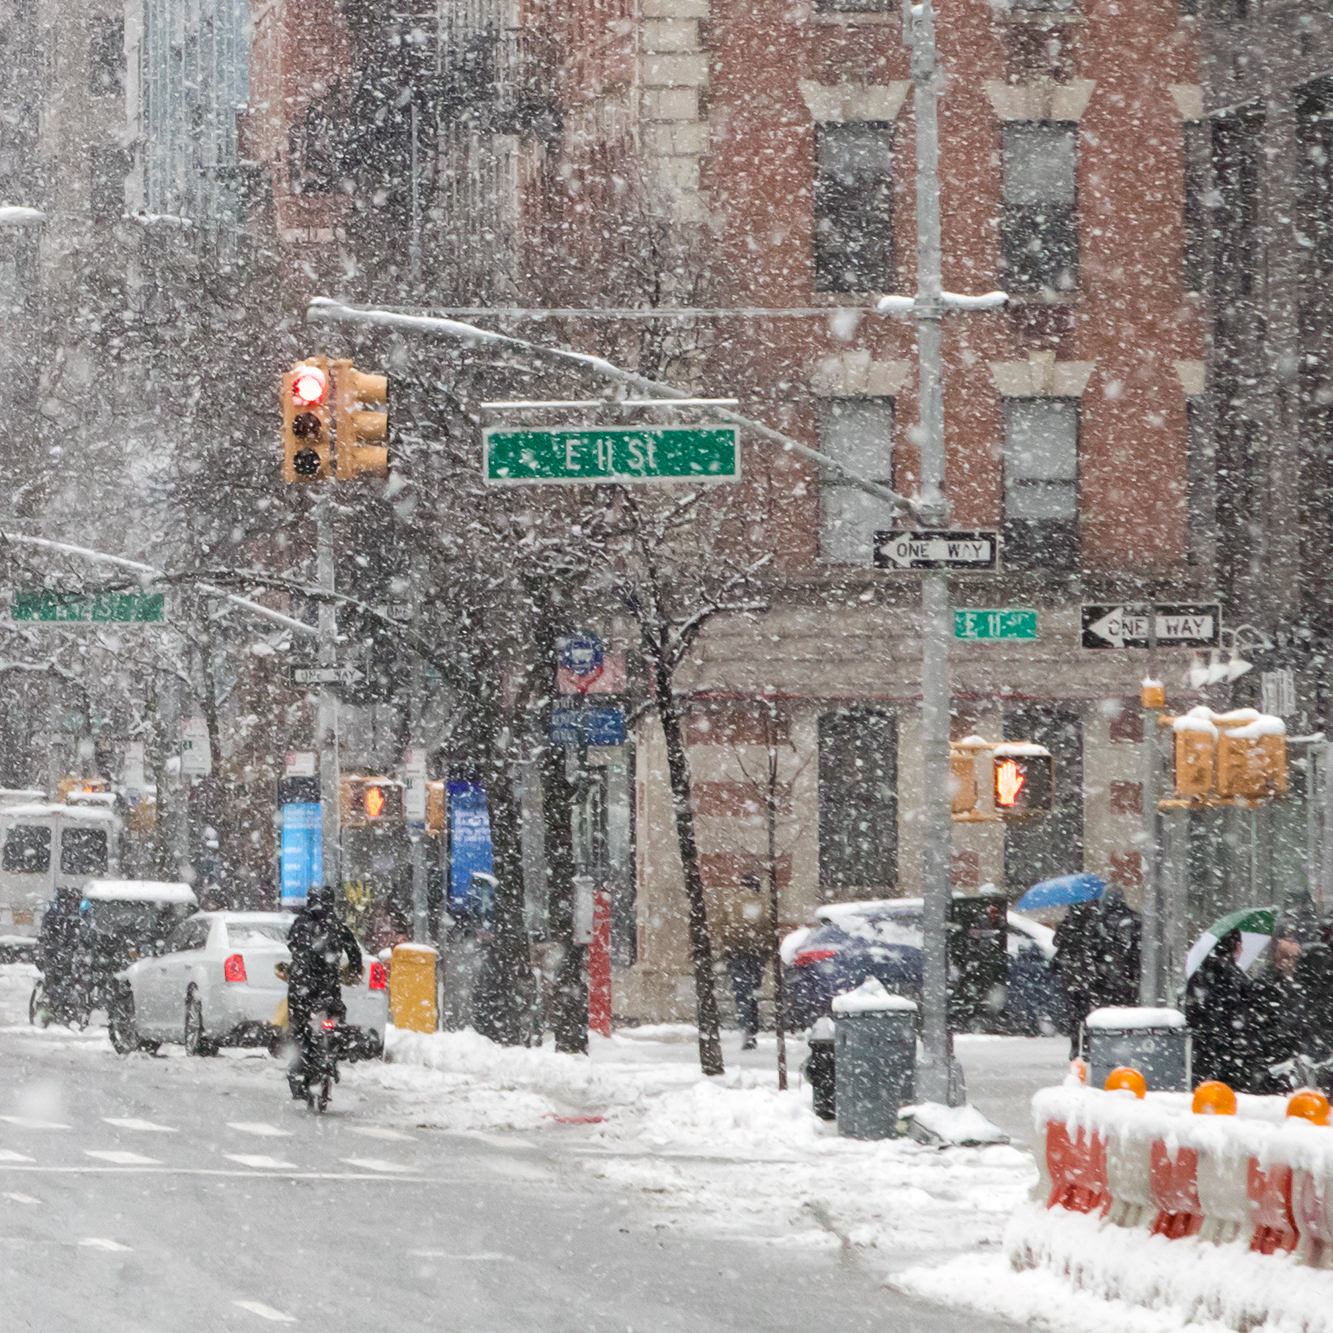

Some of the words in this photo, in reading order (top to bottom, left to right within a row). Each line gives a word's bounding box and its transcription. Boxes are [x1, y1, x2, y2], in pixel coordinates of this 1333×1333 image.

[565, 438, 582, 471] E
[596, 438, 614, 471] 11
[627, 437, 657, 470] St
[896, 542, 931, 558] ONE
[946, 542, 983, 559] WAY
[964, 613, 978, 637] E
[988, 613, 1001, 637] 11
[1107, 618, 1148, 637] ONE
[1165, 617, 1205, 636] WAY
